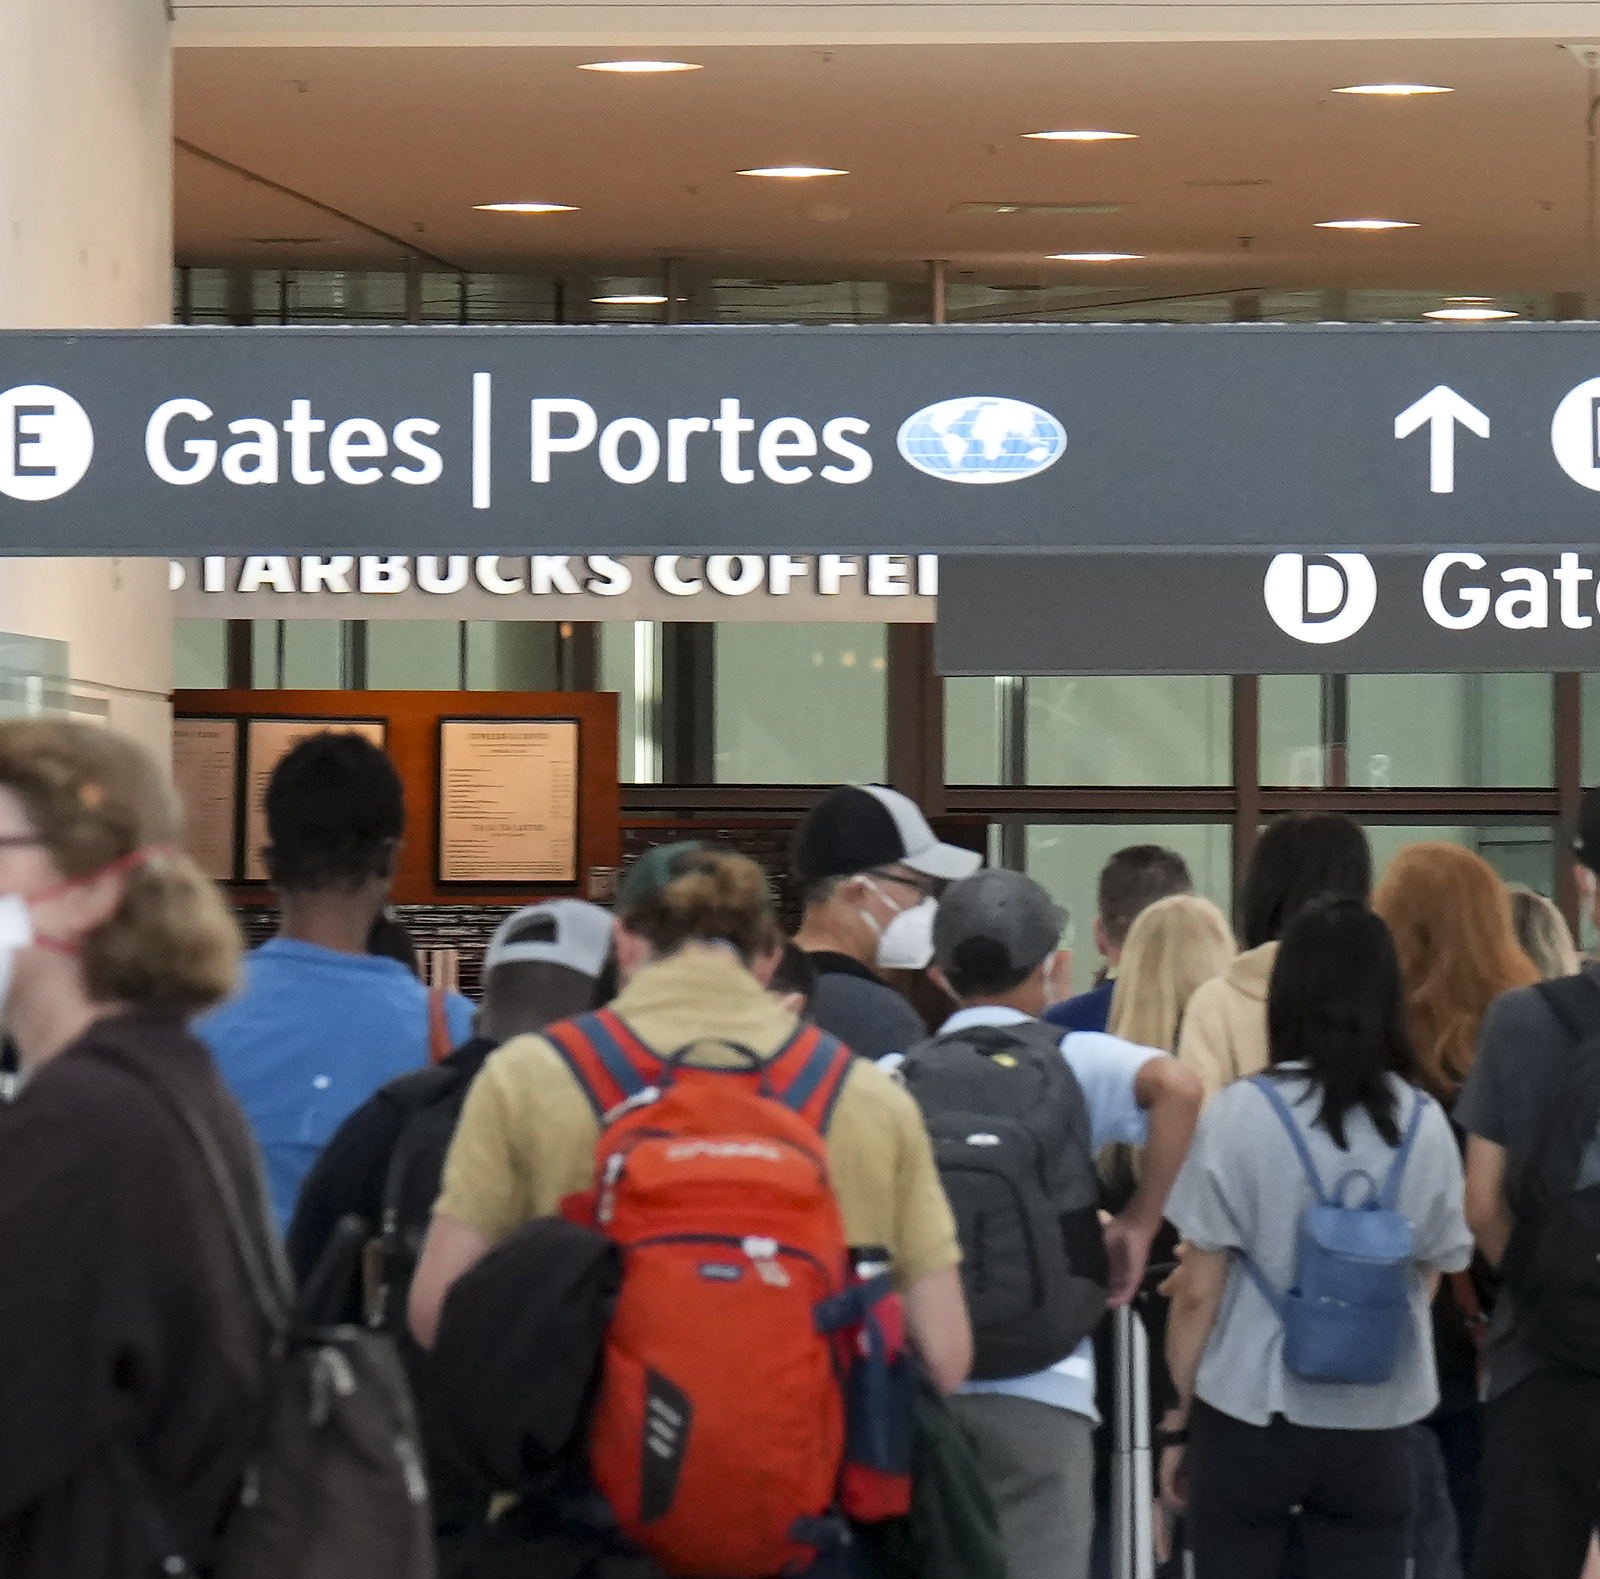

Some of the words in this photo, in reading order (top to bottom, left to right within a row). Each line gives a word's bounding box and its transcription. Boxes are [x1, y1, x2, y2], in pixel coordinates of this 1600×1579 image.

[14, 405, 56, 477] E
[145, 398, 444, 486] Gates
[530, 397, 873, 486] Portes
[169, 556, 633, 596] TARBUCKS
[1301, 554, 1349, 624] D
